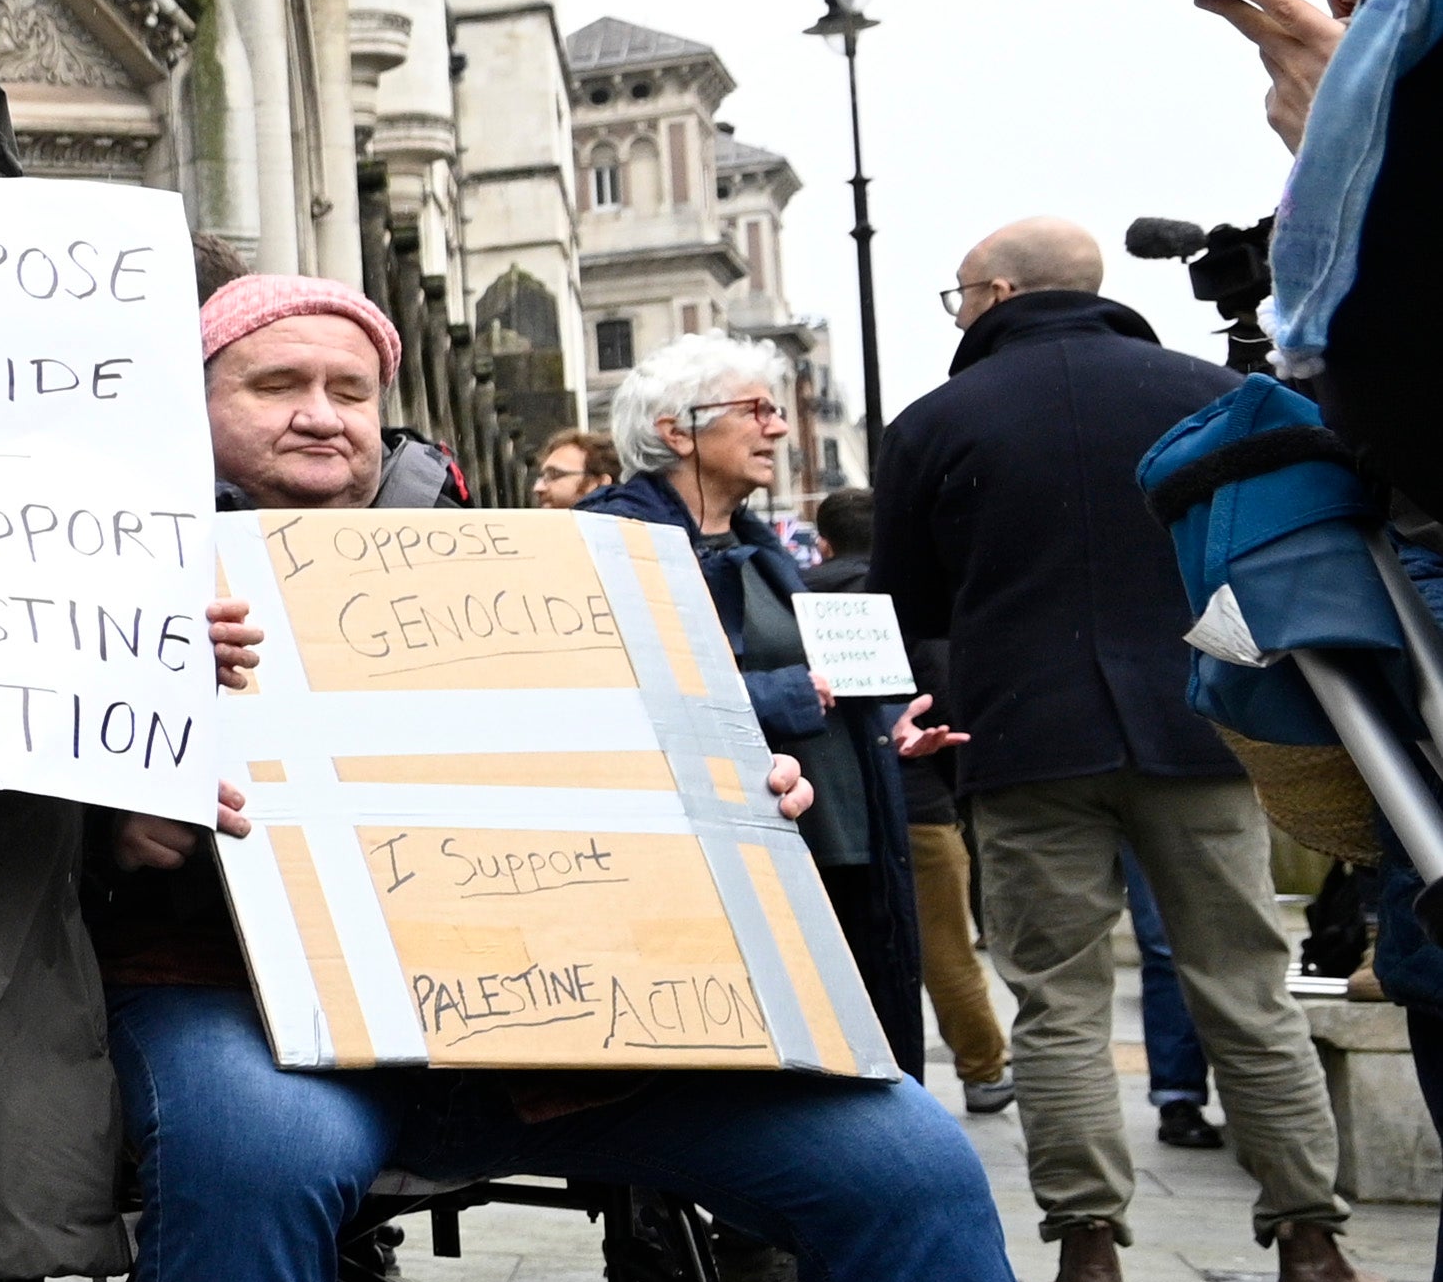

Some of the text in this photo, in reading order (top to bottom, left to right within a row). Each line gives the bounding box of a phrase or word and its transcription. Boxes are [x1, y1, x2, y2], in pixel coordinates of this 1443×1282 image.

[267, 516, 520, 580] I OPPOSE
[338, 590, 615, 659] GENOCIDE
[815, 601, 870, 618] OPPOSE
[816, 629, 889, 640] GENOCIDE
[369, 833, 612, 893] I Support
[412, 964, 602, 1031] PALESTINE
[603, 975, 769, 1048] ACTION
